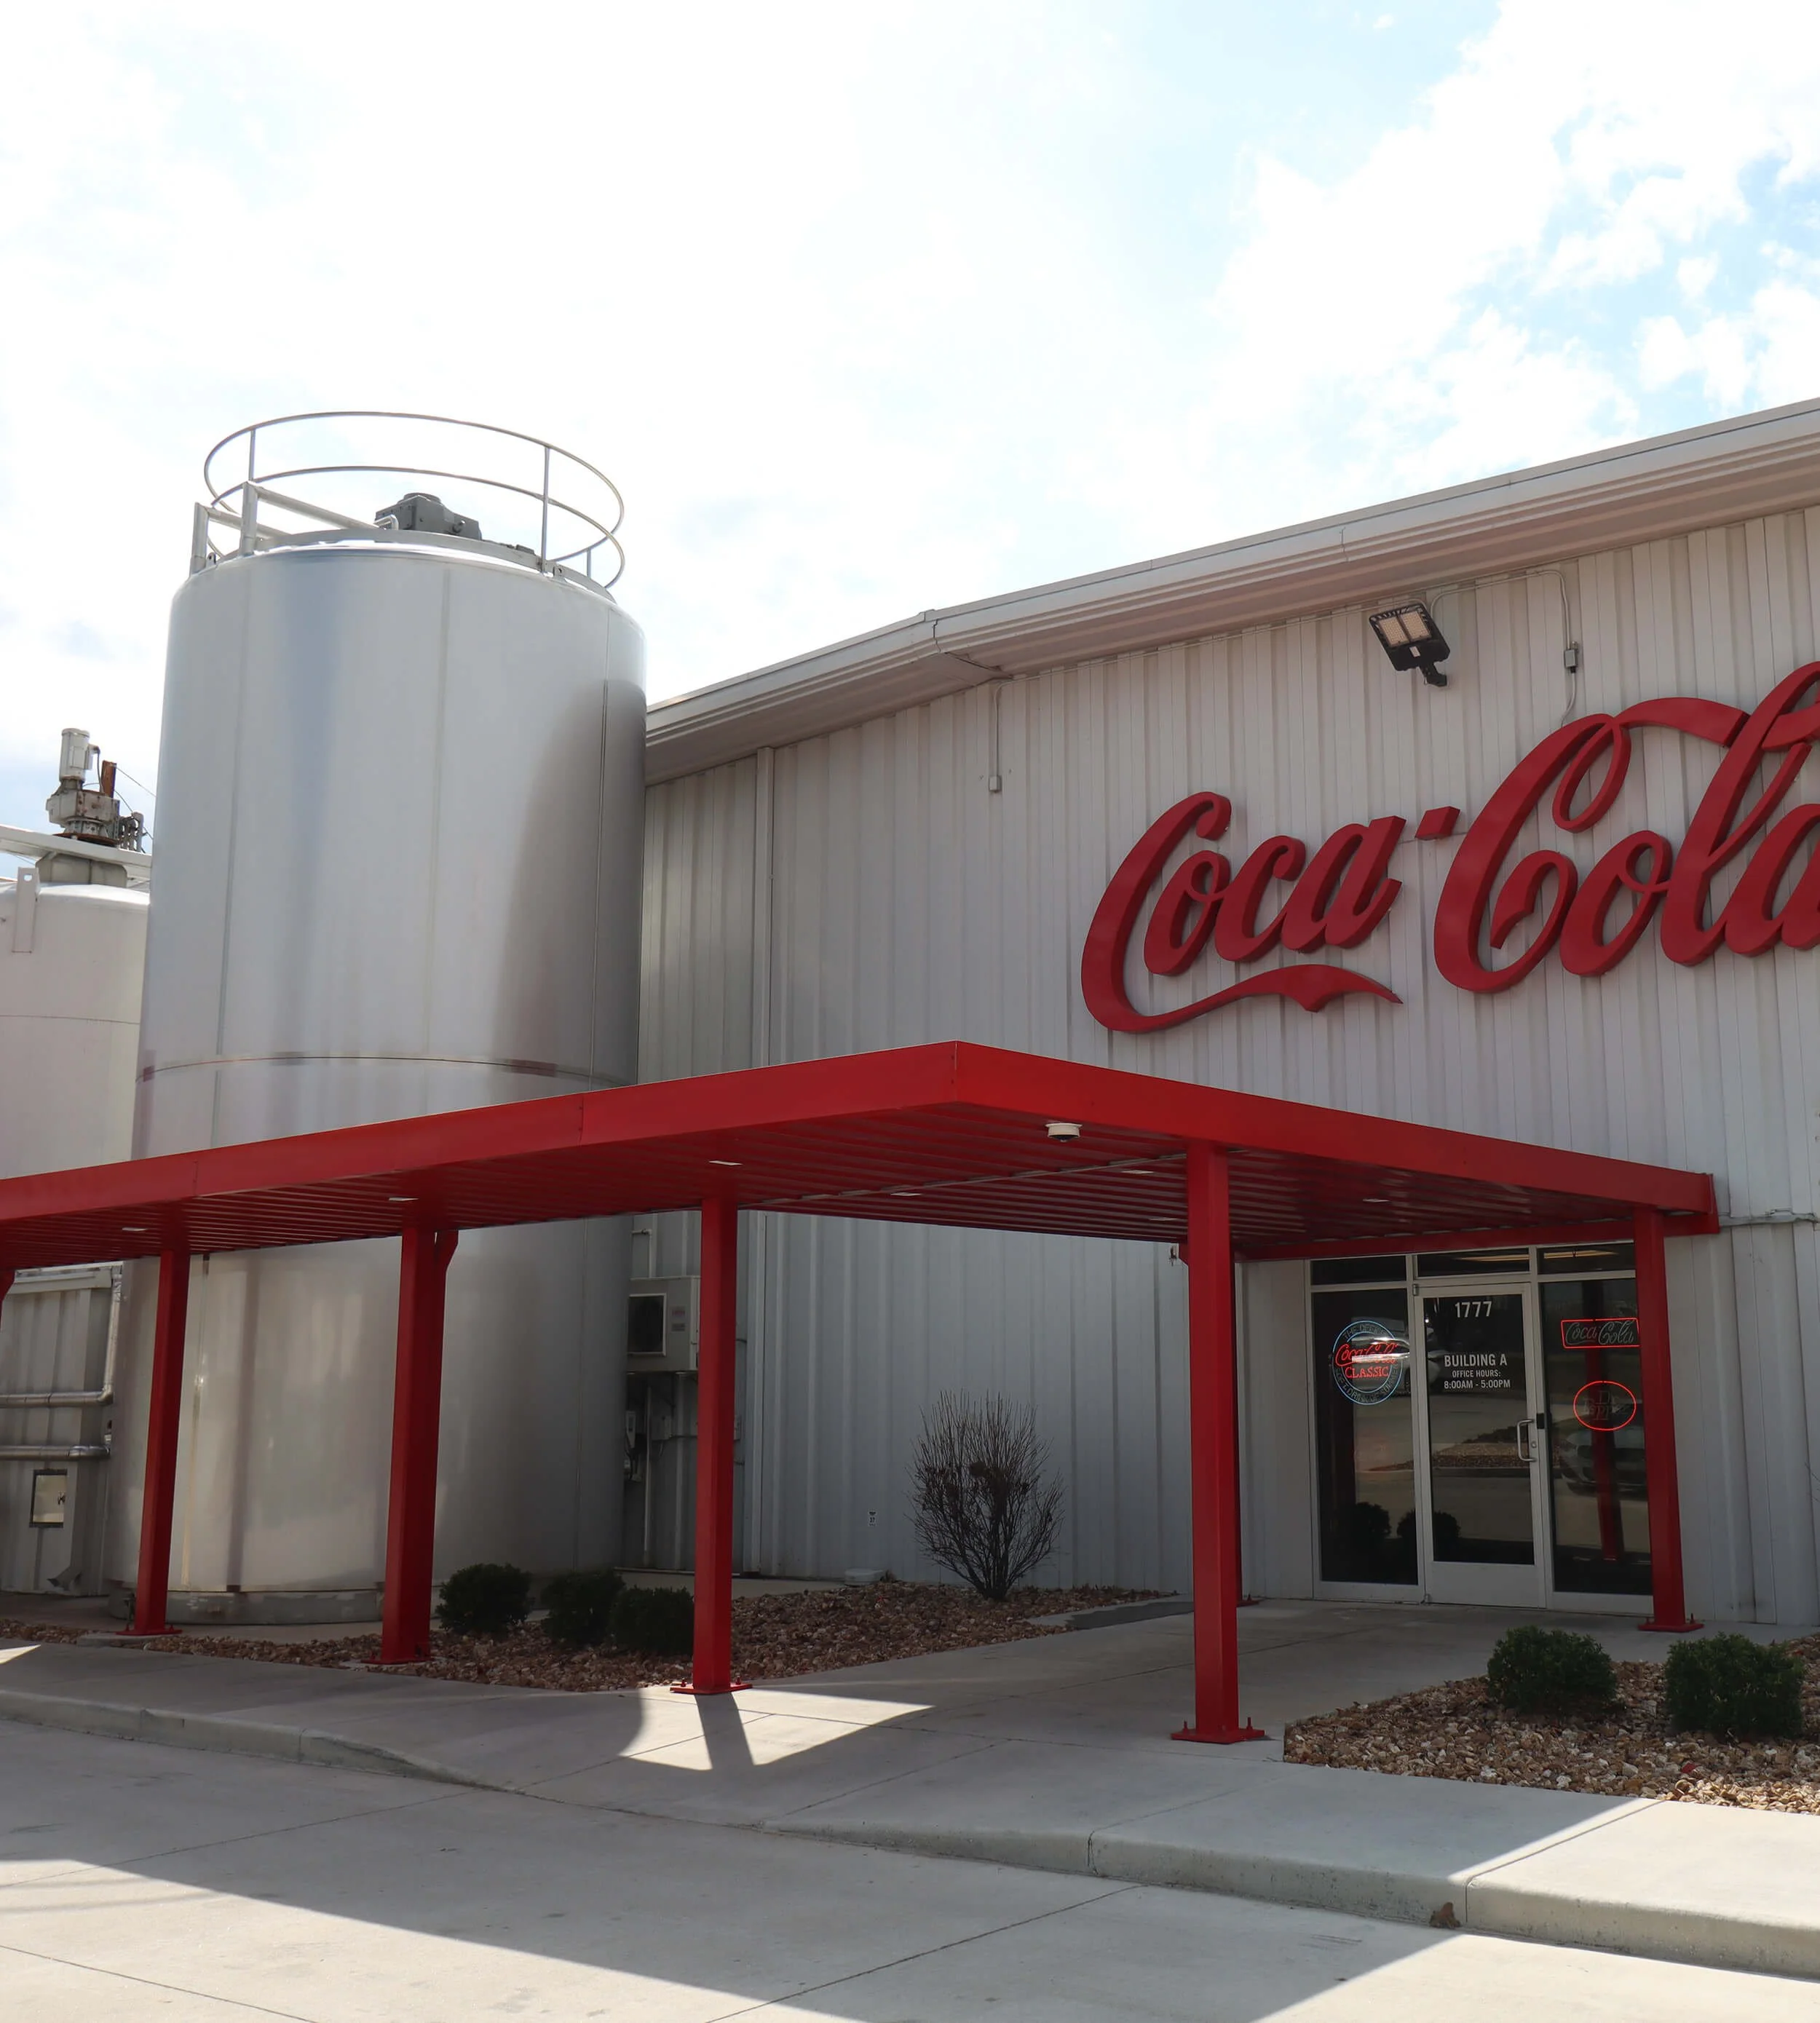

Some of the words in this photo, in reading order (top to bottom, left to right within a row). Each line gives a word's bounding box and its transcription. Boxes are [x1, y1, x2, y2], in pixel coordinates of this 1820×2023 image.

[1455, 1301, 1492, 1318] 1777
[1335, 1344, 1398, 1366] Coca-Cl
[1444, 1354, 1496, 1366] BUILDING
[1500, 1353, 1508, 1366] A
[1345, 1366, 1389, 1378] CLASSIC
[1452, 1370, 1474, 1378] OFFICE
[1476, 1369, 1501, 1377] HOURS:
[1444, 1380, 1473, 1389] 8:00AM
[1481, 1379, 1511, 1388] 5:00PM
